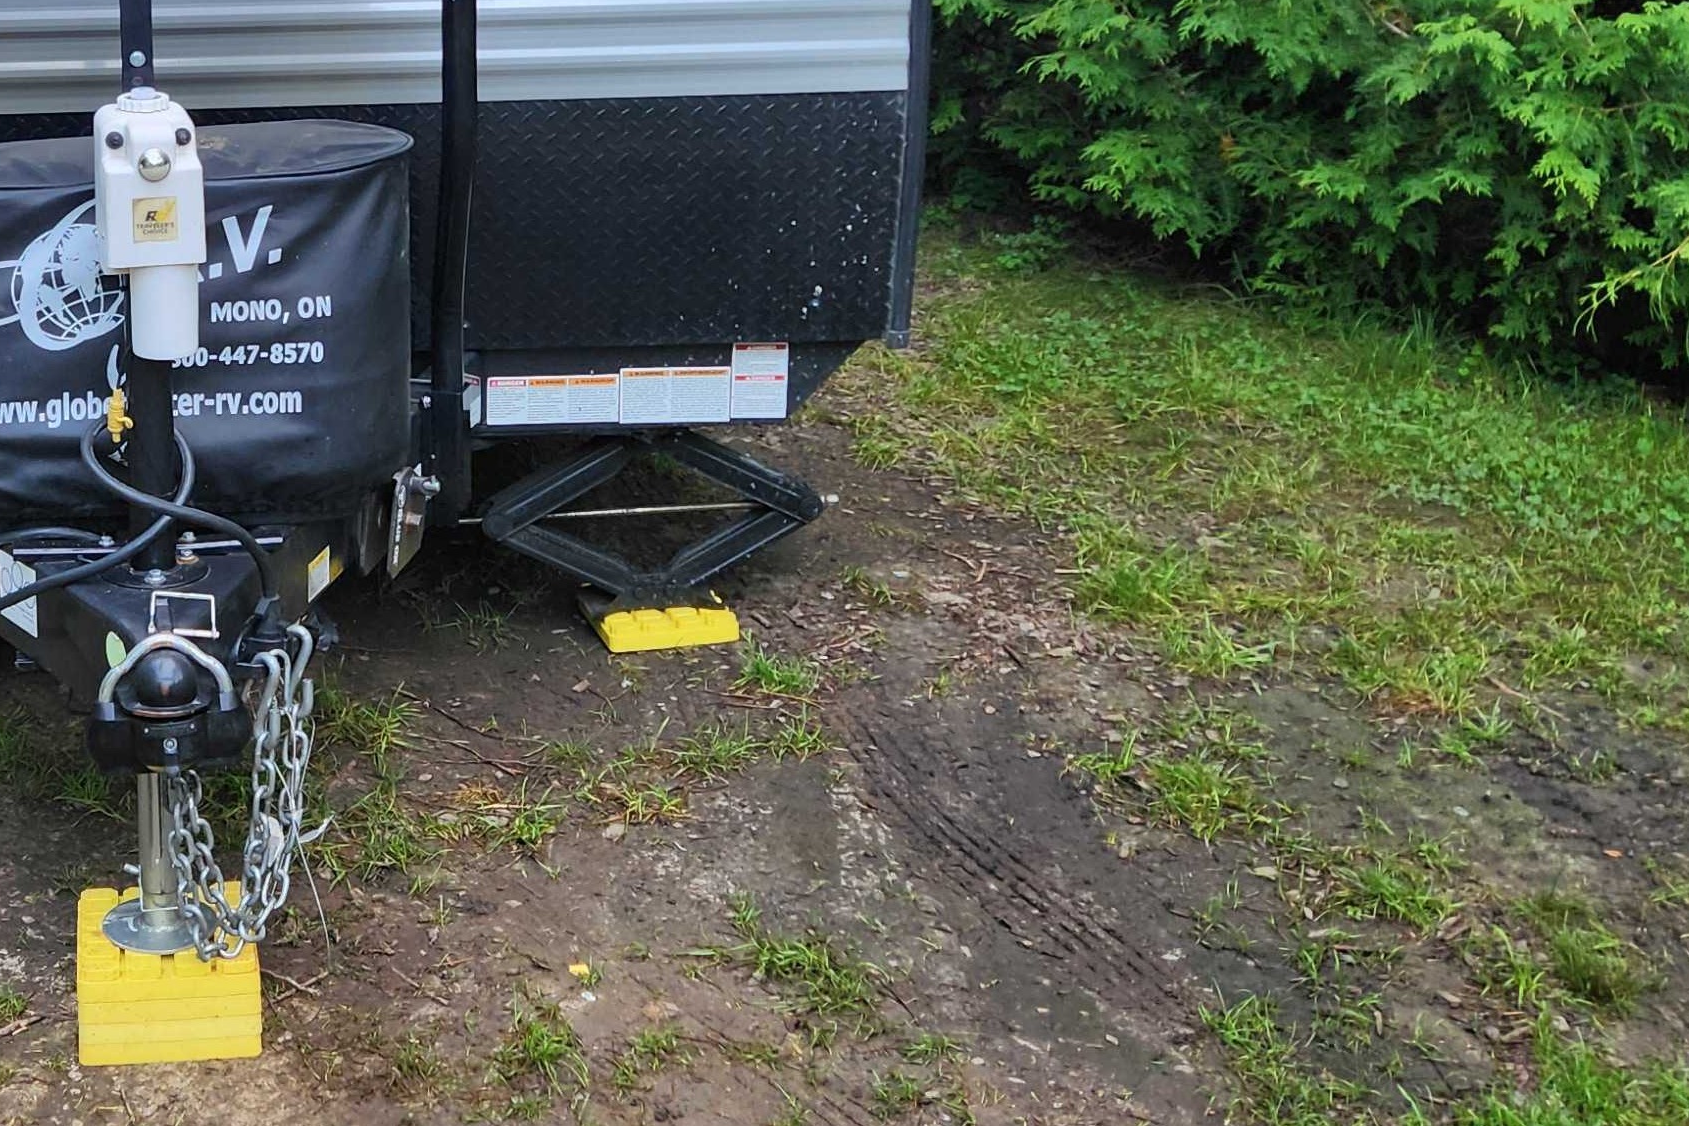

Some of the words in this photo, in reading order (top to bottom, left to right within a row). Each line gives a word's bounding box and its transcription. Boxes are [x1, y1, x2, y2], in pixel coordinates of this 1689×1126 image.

[197, 205, 282, 282] .V.
[211, 299, 290, 324] MONO,
[297, 295, 332, 319] ON
